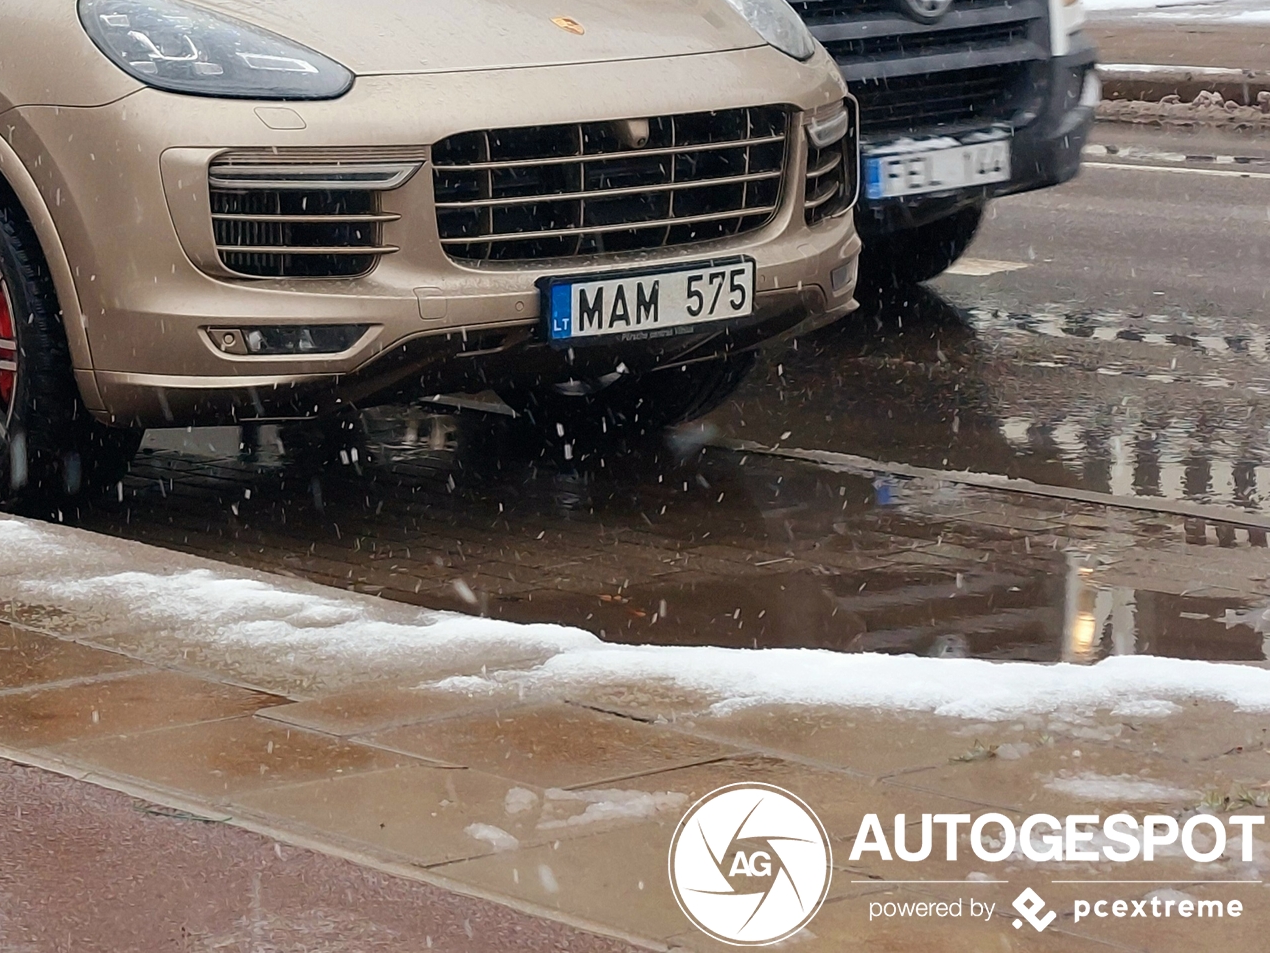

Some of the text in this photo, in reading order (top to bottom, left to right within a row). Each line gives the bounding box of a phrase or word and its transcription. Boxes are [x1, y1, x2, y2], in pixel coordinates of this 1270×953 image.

[579, 268, 747, 332] MAM 575
[553, 318, 570, 331] LT
